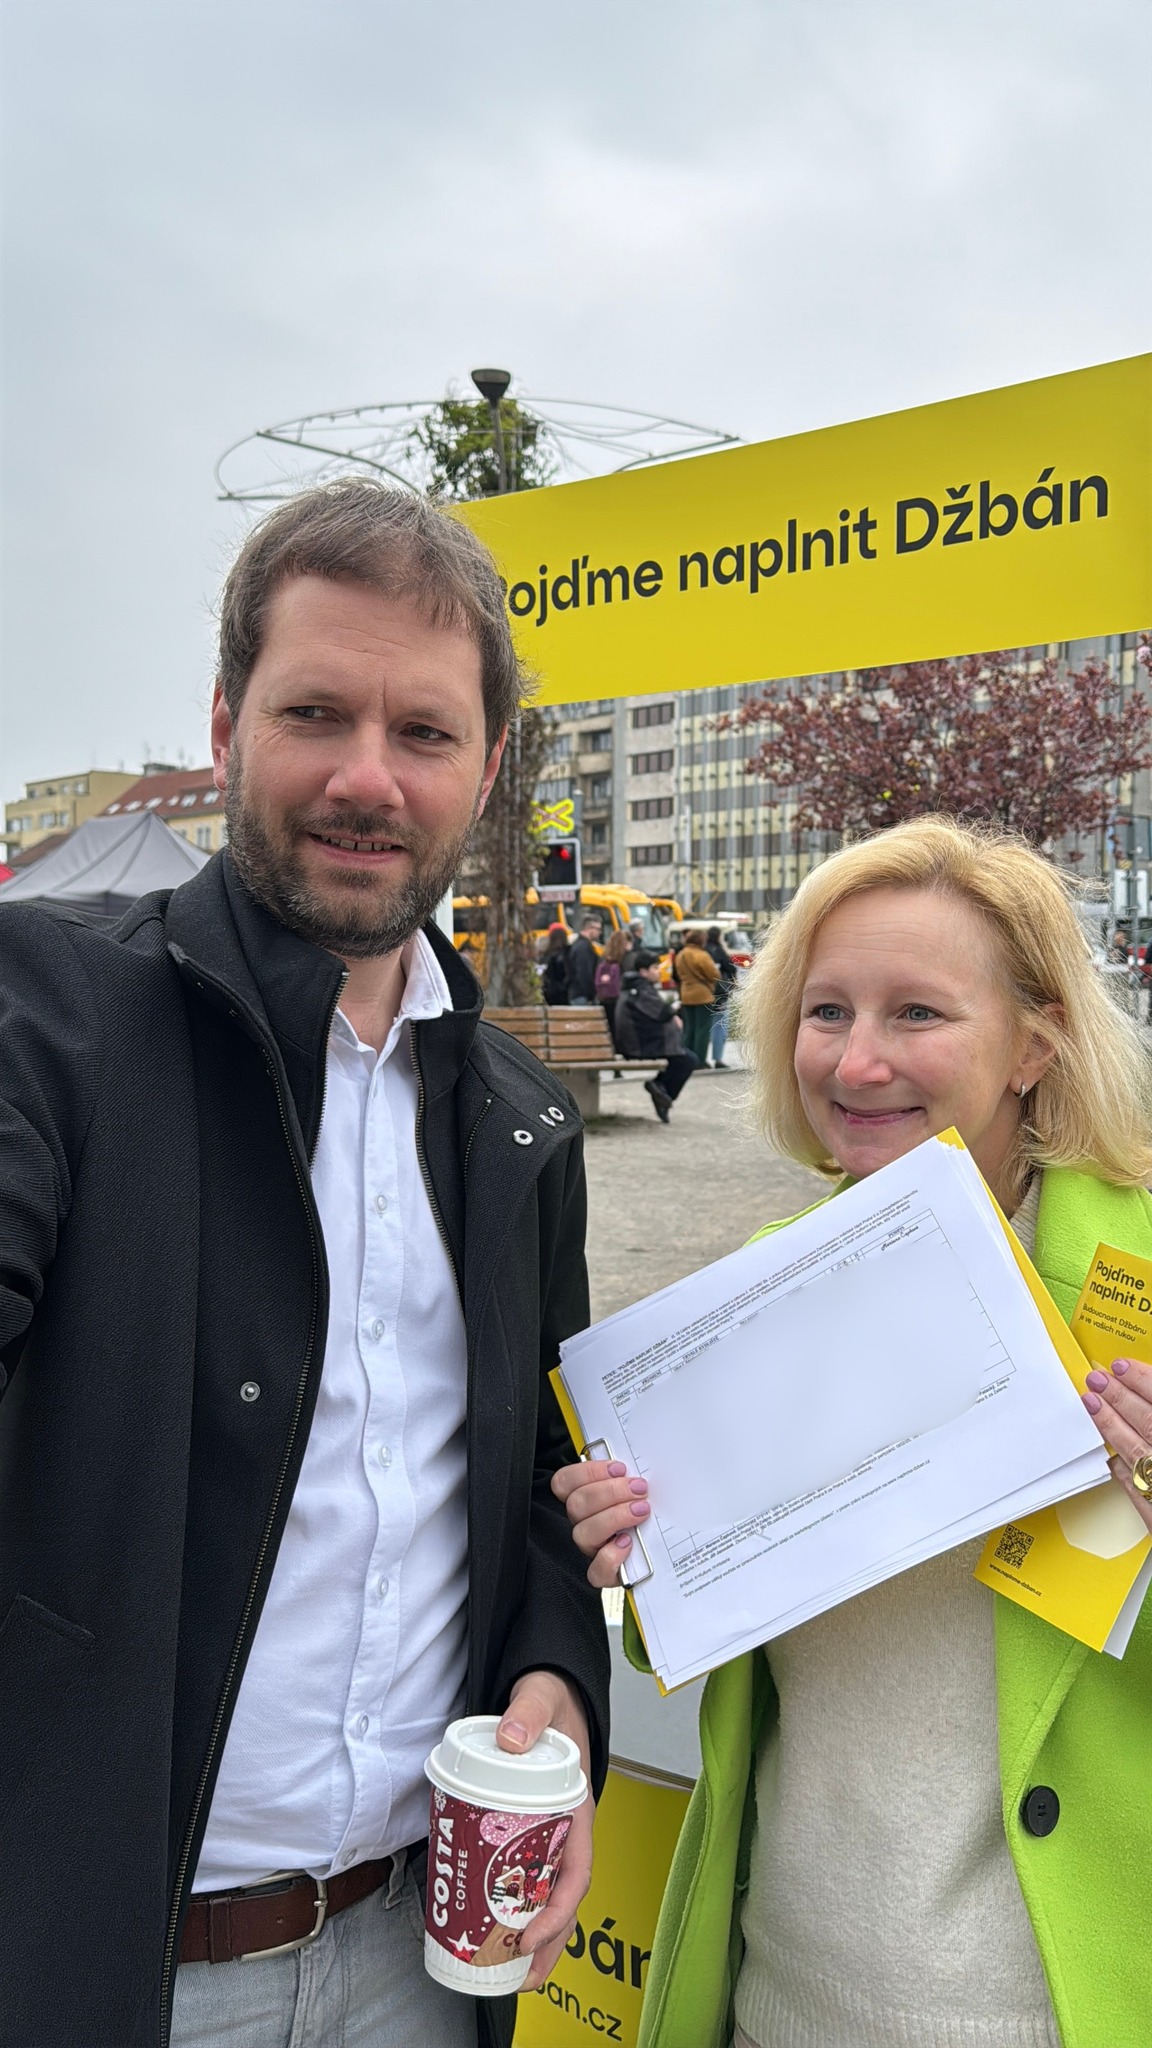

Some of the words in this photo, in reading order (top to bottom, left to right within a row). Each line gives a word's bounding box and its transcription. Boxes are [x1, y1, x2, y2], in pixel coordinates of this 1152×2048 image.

[500, 555, 663, 627] ojďme
[678, 507, 878, 594] naplnit
[895, 467, 1109, 554] Džbán
[1089, 1281, 1136, 1308] naplnit
[1138, 1297, 1152, 1316] D
[1095, 1260, 1145, 1290] Pojďme
[1082, 1303, 1118, 1324] Budoucnost
[1119, 1318, 1147, 1335] Džbánu
[1093, 1319, 1114, 1334] vašich
[1115, 1329, 1136, 1342] rukou
[433, 1817, 454, 1928] COSTA
[455, 1849, 468, 1911] COFFEE
[535, 1981, 622, 2042] an.cz
